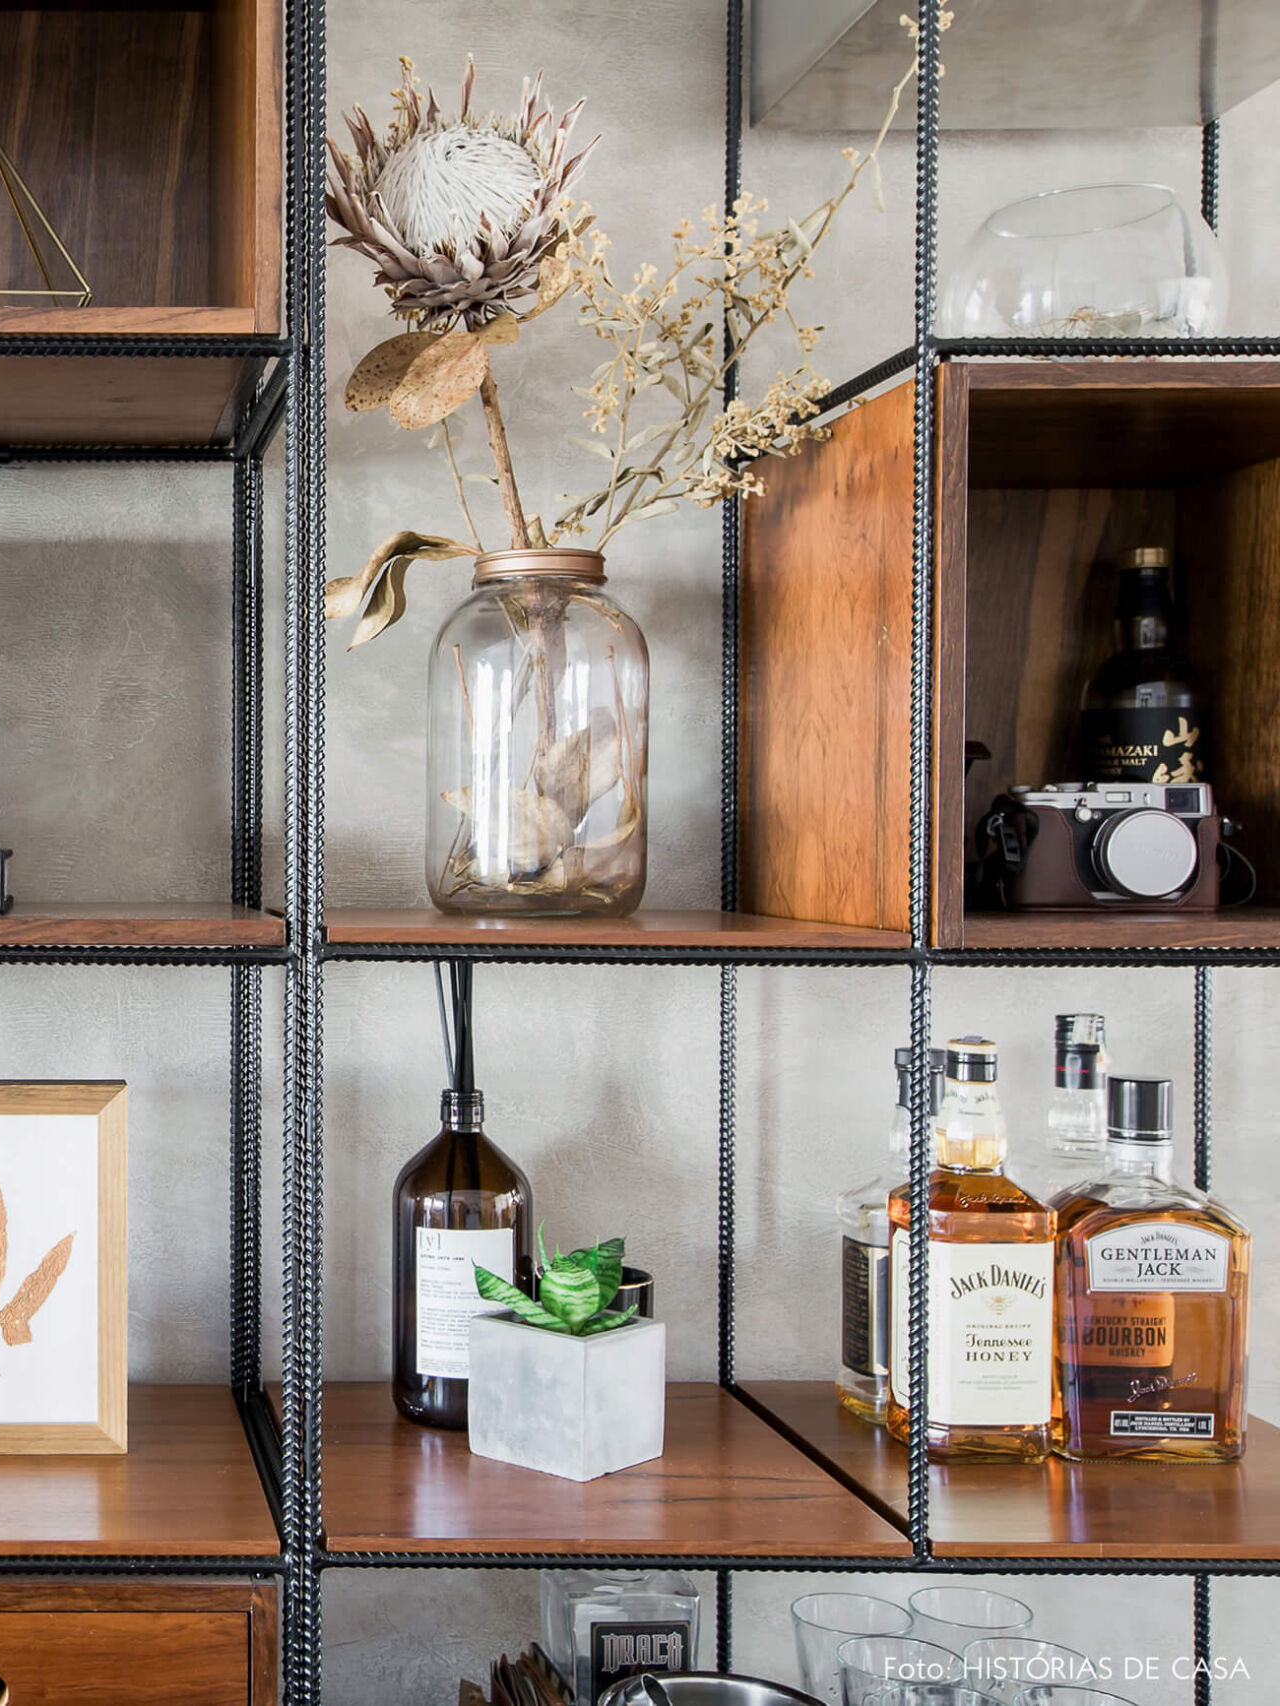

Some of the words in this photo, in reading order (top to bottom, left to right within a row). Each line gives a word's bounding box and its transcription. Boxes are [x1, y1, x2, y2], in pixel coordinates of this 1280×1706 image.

[1100, 1247, 1217, 1261] GENTLEMAN
[1137, 1262, 1182, 1278] JACK
[950, 1271, 988, 1300] JACK
[965, 1333, 1032, 1347] Tennessee
[1082, 1326, 1166, 1347] BOURBON
[965, 1351, 1032, 1362] HONEY
[1109, 1348, 1146, 1357] WHISKEY
